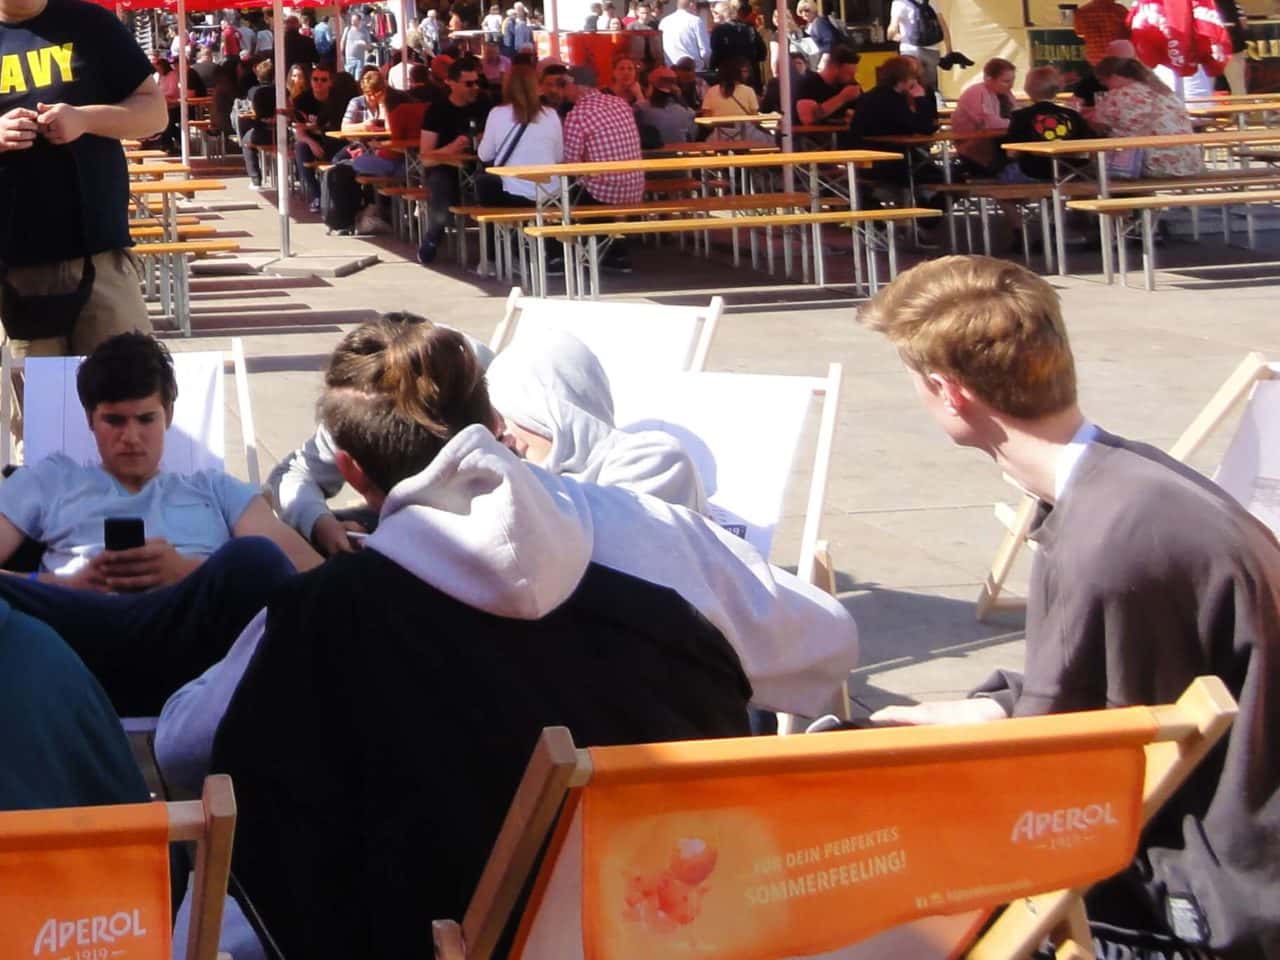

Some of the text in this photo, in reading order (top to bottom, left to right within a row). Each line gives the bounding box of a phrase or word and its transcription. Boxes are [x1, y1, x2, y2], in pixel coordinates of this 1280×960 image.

[823, 825, 900, 859] PERFEKTES
[1011, 802, 1118, 844] APEROL
[33, 908, 147, 956] APEROL
